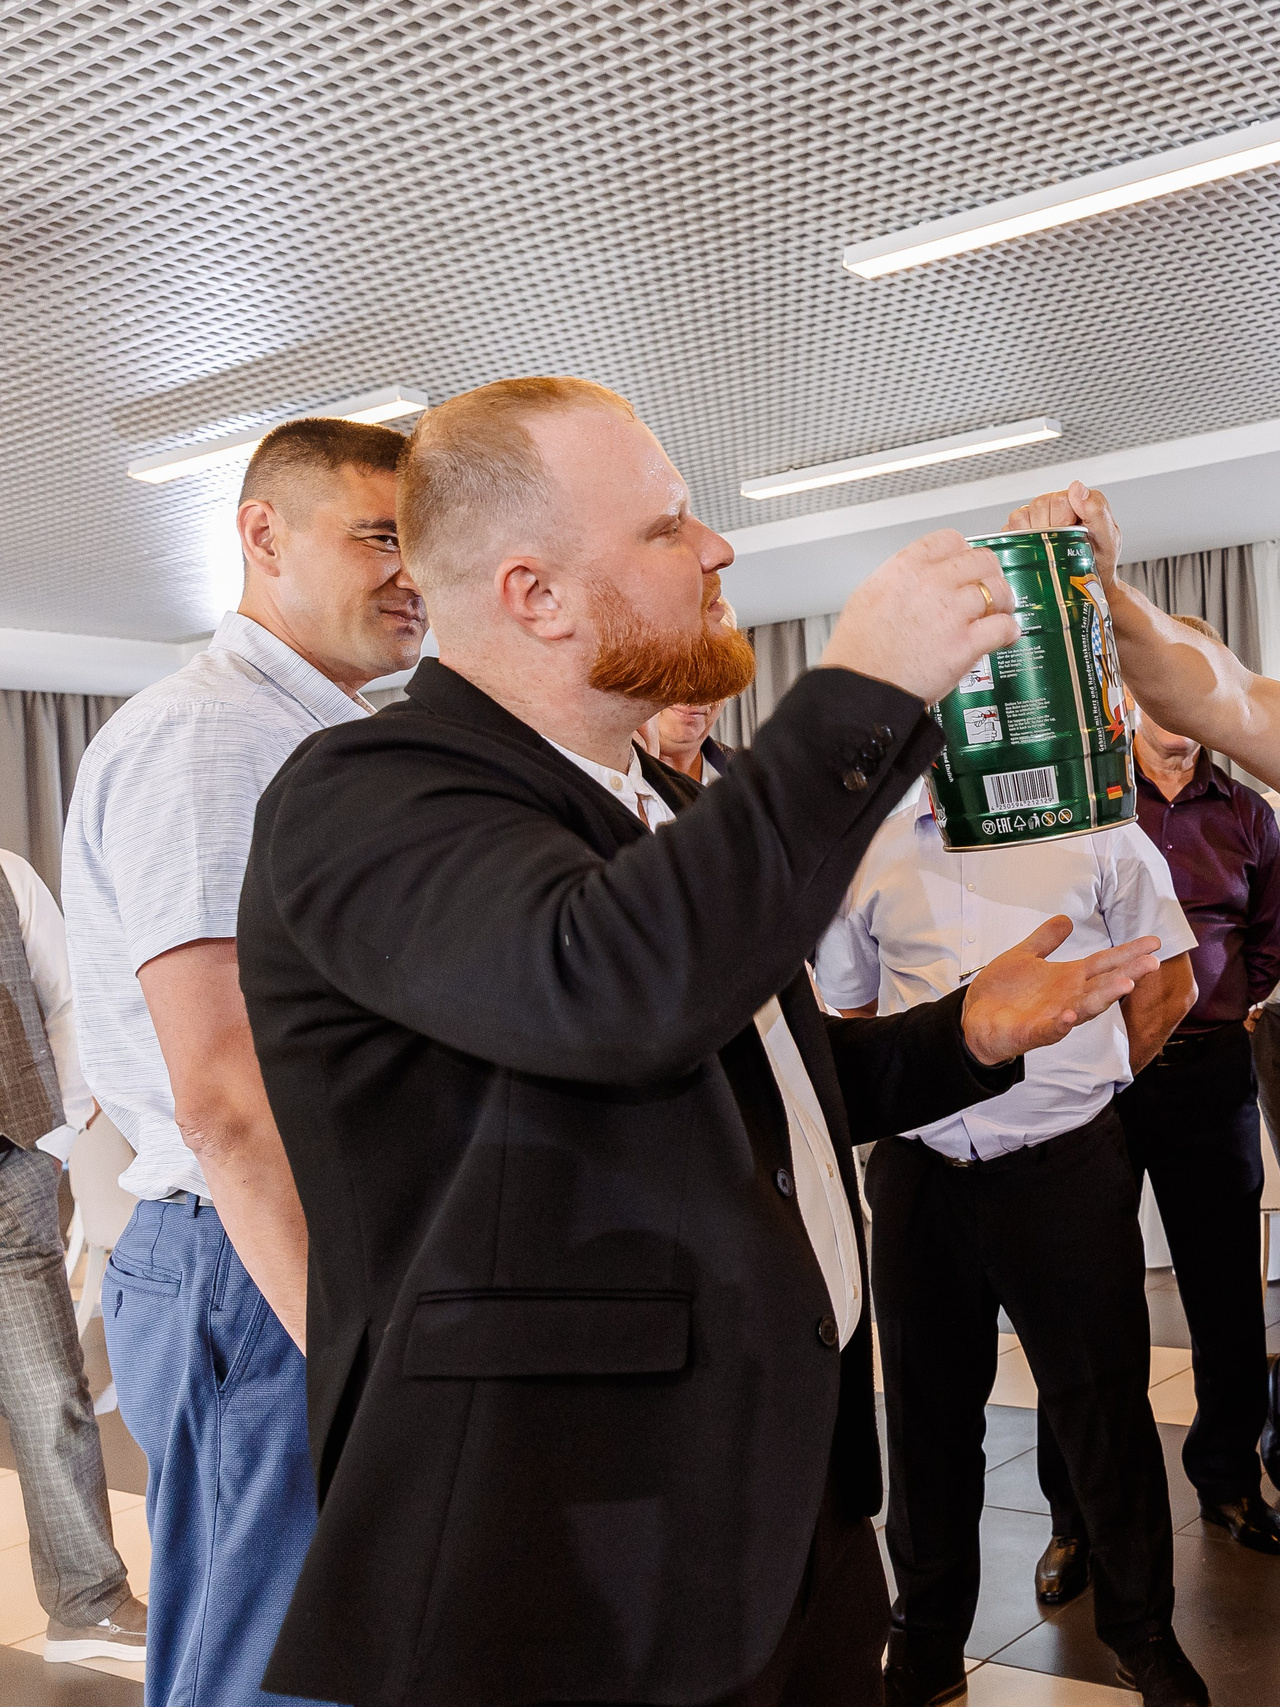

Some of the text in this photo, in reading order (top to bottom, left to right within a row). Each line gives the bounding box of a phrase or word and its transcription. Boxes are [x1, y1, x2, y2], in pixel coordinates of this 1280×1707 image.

[1088, 687, 1096, 699] und
[1091, 700, 1099, 714] Herz
[944, 763, 955, 783] Ehrlich
